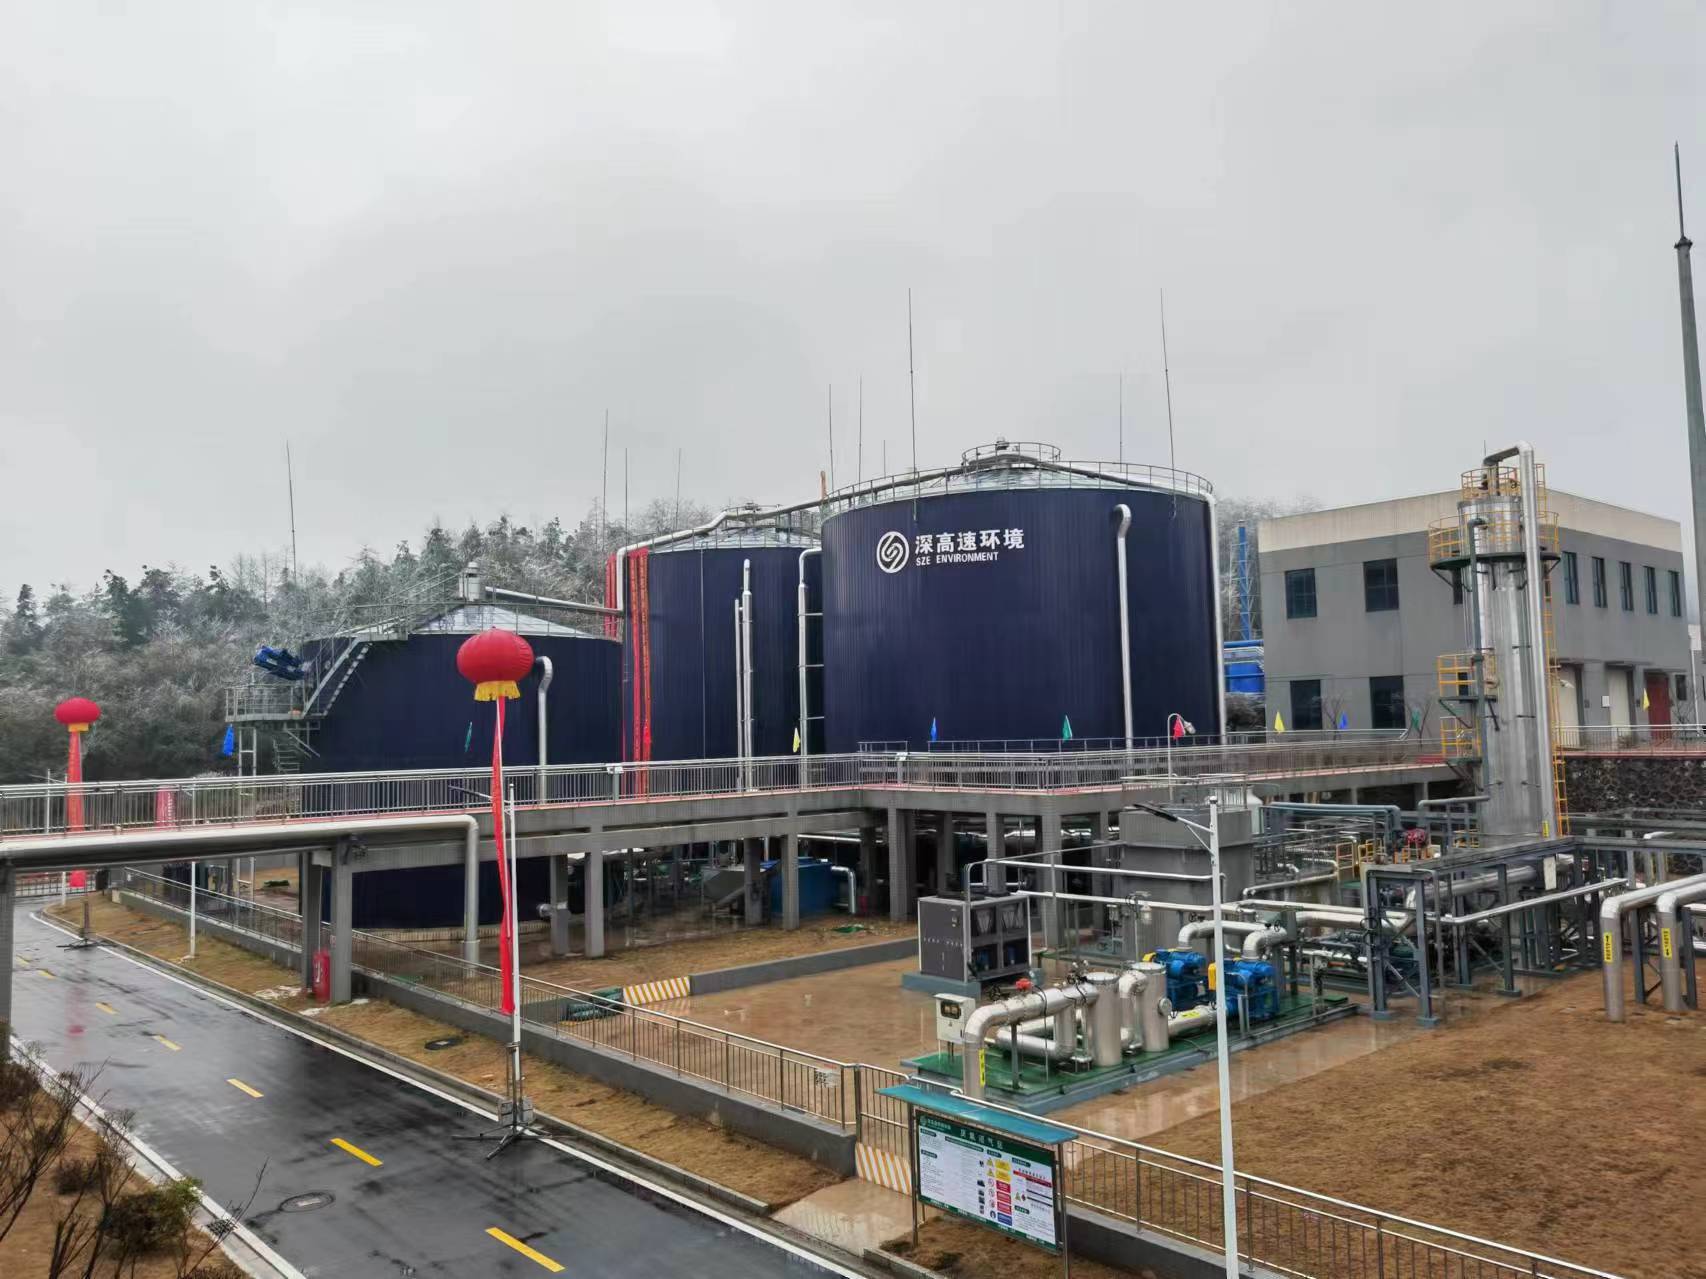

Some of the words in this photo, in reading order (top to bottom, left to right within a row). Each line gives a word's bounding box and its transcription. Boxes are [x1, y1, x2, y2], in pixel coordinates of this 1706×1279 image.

[915, 528, 1024, 554] 深高速环境
[916, 557, 931, 566] SZE
[936, 552, 998, 564] ENVIRONMENT
